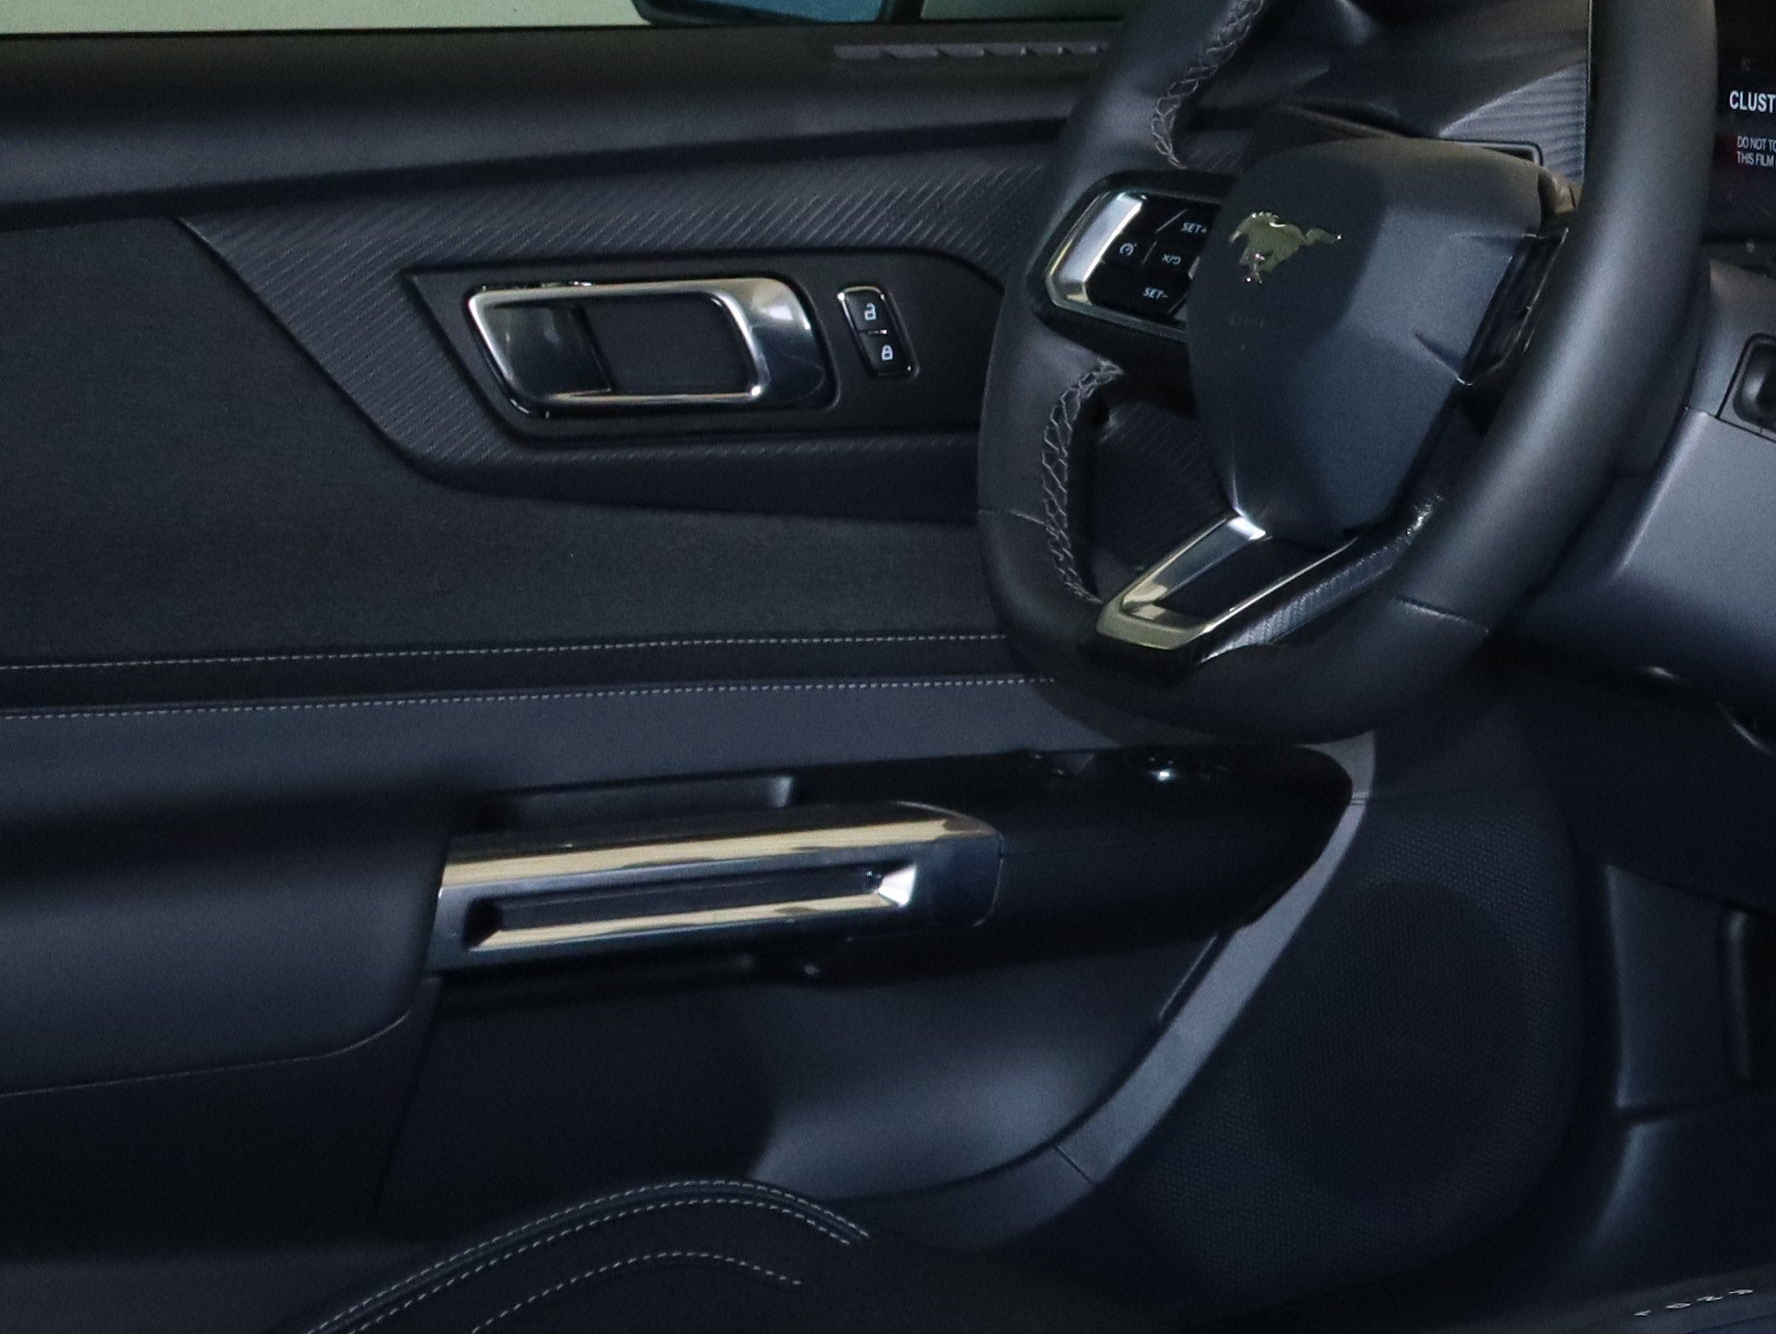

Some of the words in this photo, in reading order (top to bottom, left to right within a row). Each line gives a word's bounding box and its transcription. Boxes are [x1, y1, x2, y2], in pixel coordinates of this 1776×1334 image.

[1736, 135, 1749, 148] DO
[1750, 137, 1766, 150] NOT
[1736, 151, 1754, 165] THIS
[1755, 153, 1774, 167] FILM
[1181, 221, 1208, 234] SET+
